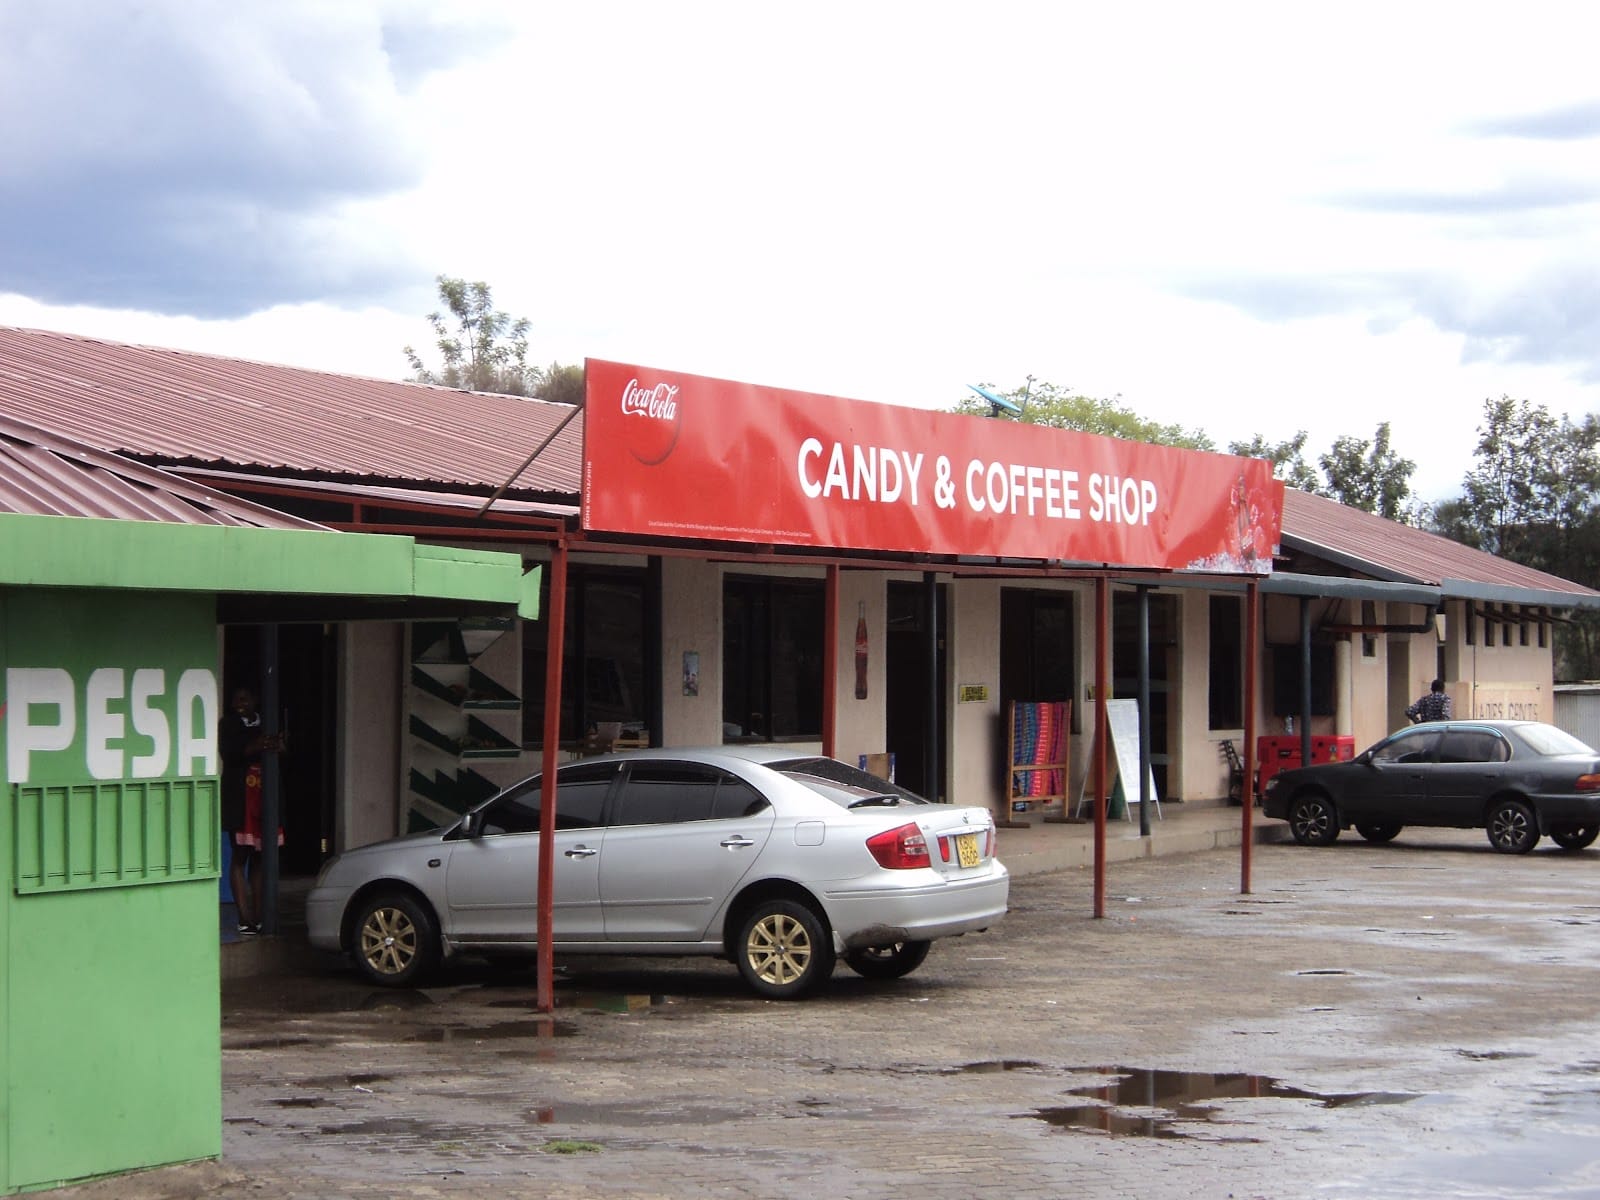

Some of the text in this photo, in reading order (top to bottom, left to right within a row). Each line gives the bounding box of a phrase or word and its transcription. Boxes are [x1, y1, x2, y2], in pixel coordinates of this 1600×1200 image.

[798, 437, 1157, 526] CANDY & COFFEE SHOP
[7, 667, 218, 783] PESA
